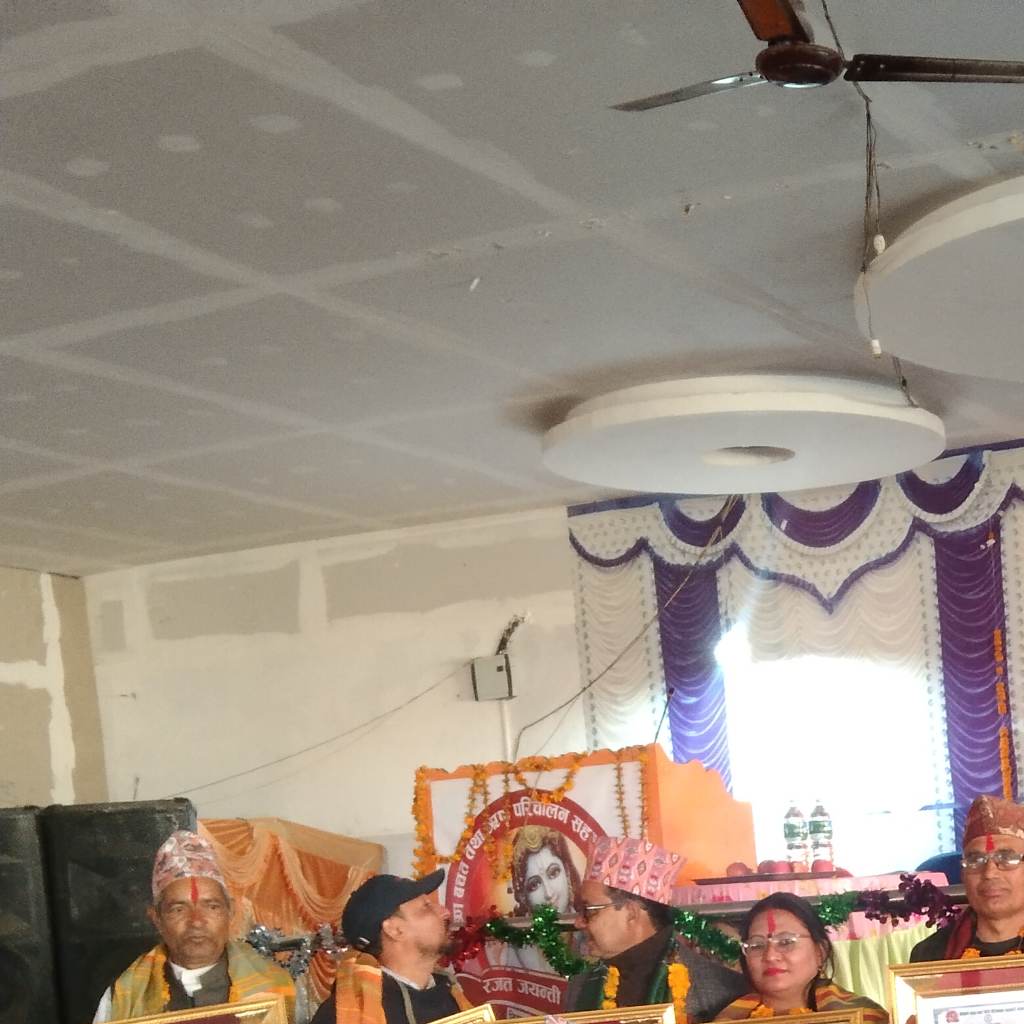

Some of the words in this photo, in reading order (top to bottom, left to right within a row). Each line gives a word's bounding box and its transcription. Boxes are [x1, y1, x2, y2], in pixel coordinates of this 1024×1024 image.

[464, 829, 486, 860] तथा
[483, 977, 513, 993] रजत
[515, 978, 561, 1005] जयन्ती
